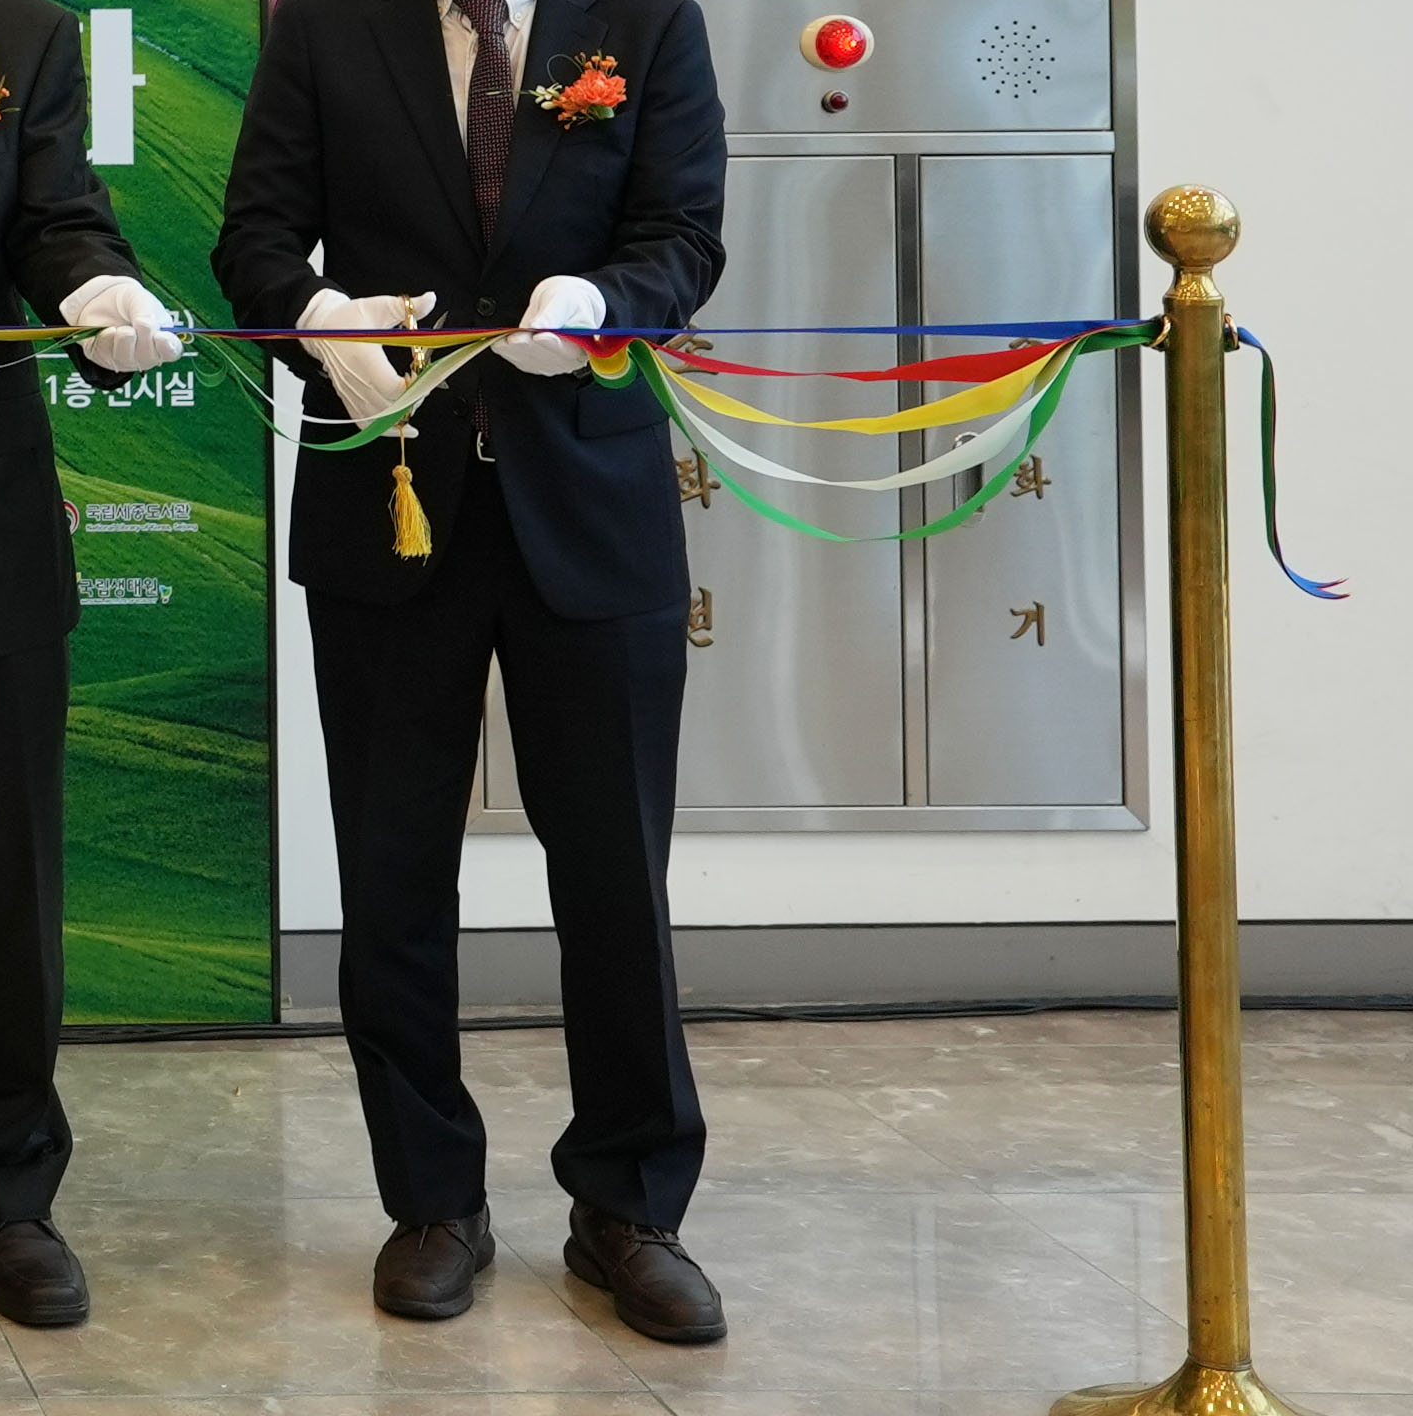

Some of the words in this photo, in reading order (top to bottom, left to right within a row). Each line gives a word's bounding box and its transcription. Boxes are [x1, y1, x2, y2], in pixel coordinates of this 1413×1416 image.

[45, 371, 96, 409] 1층
[86, 503, 191, 521] 국립세종도서관
[78, 577, 158, 598] 국립생태원
